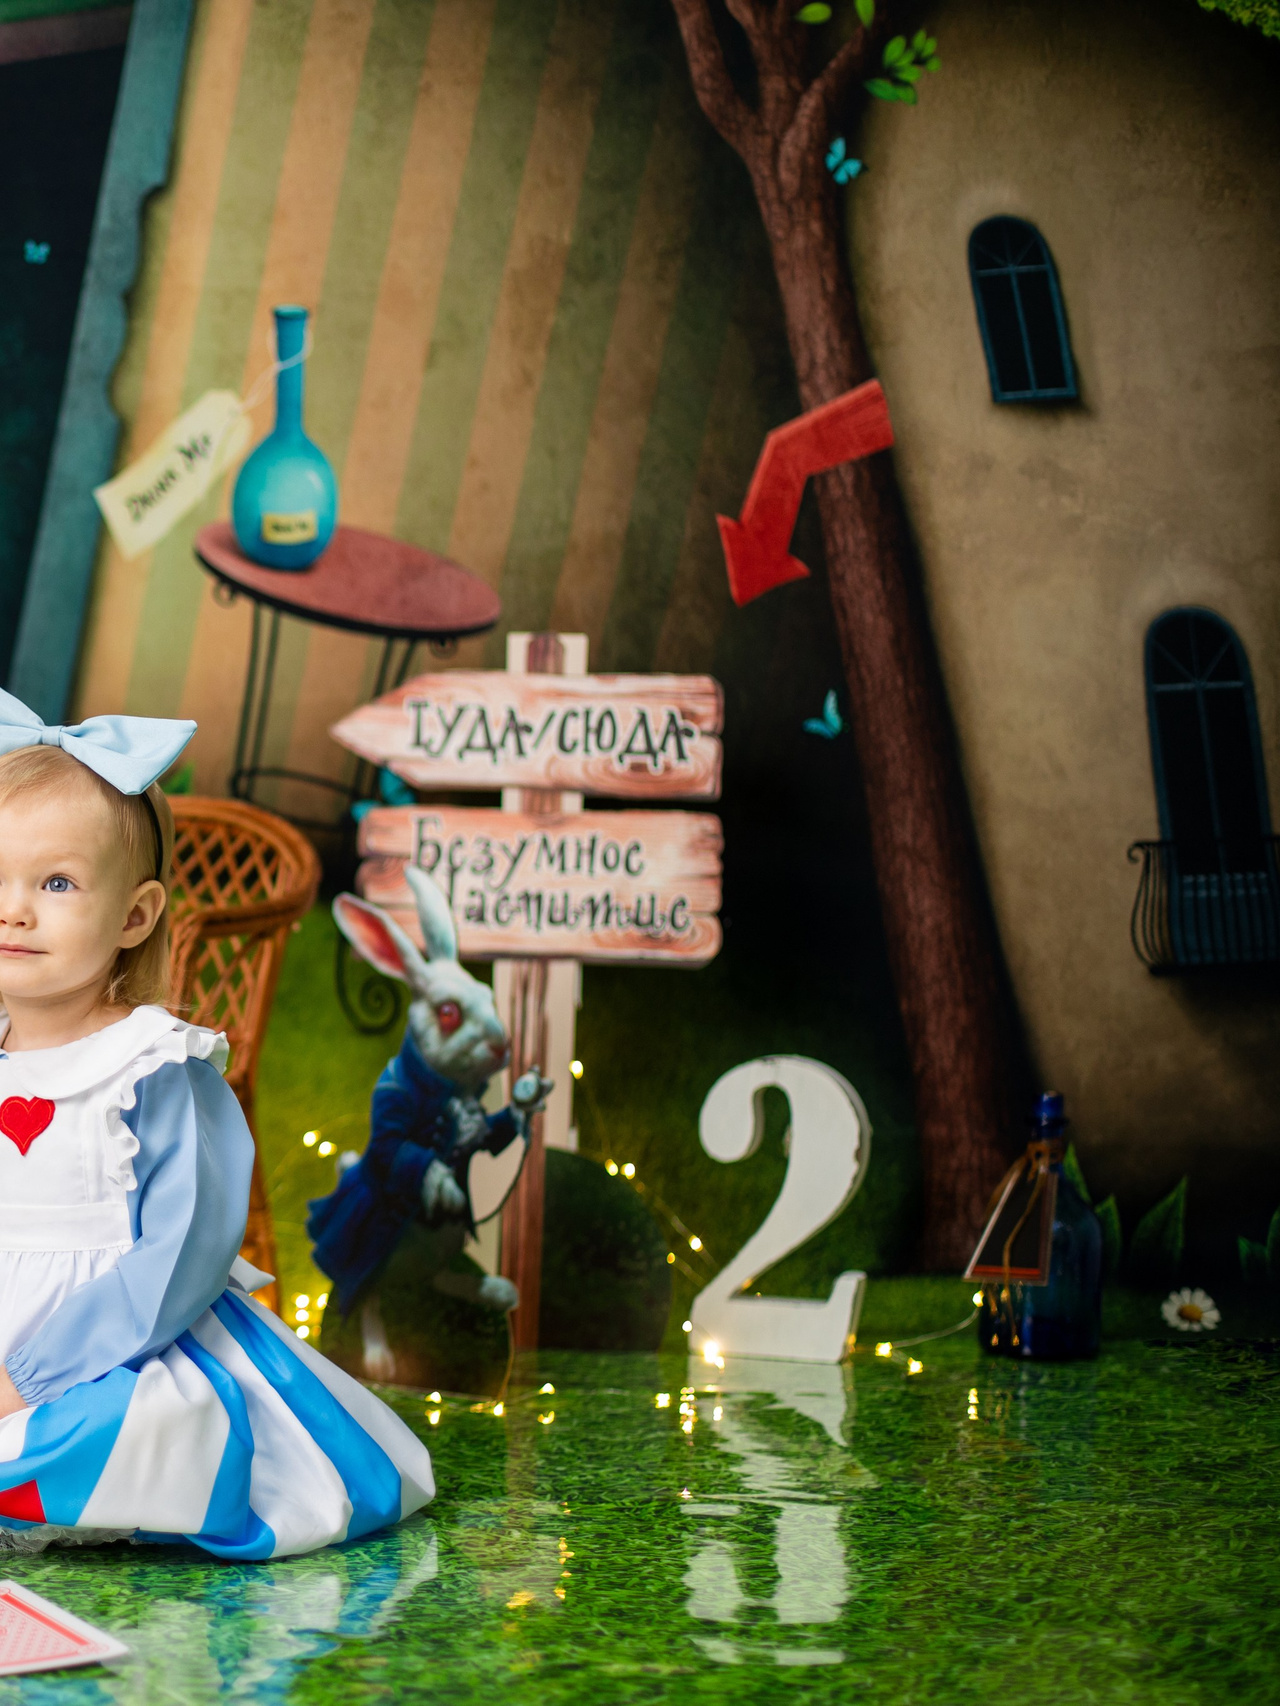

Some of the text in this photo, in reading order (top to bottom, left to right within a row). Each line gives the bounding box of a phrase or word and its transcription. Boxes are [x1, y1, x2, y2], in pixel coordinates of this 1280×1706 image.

[408, 700, 695, 767] ТУДА/СЮДА
[414, 816, 644, 892] Безумное
[688, 1054, 871, 1365] 2
